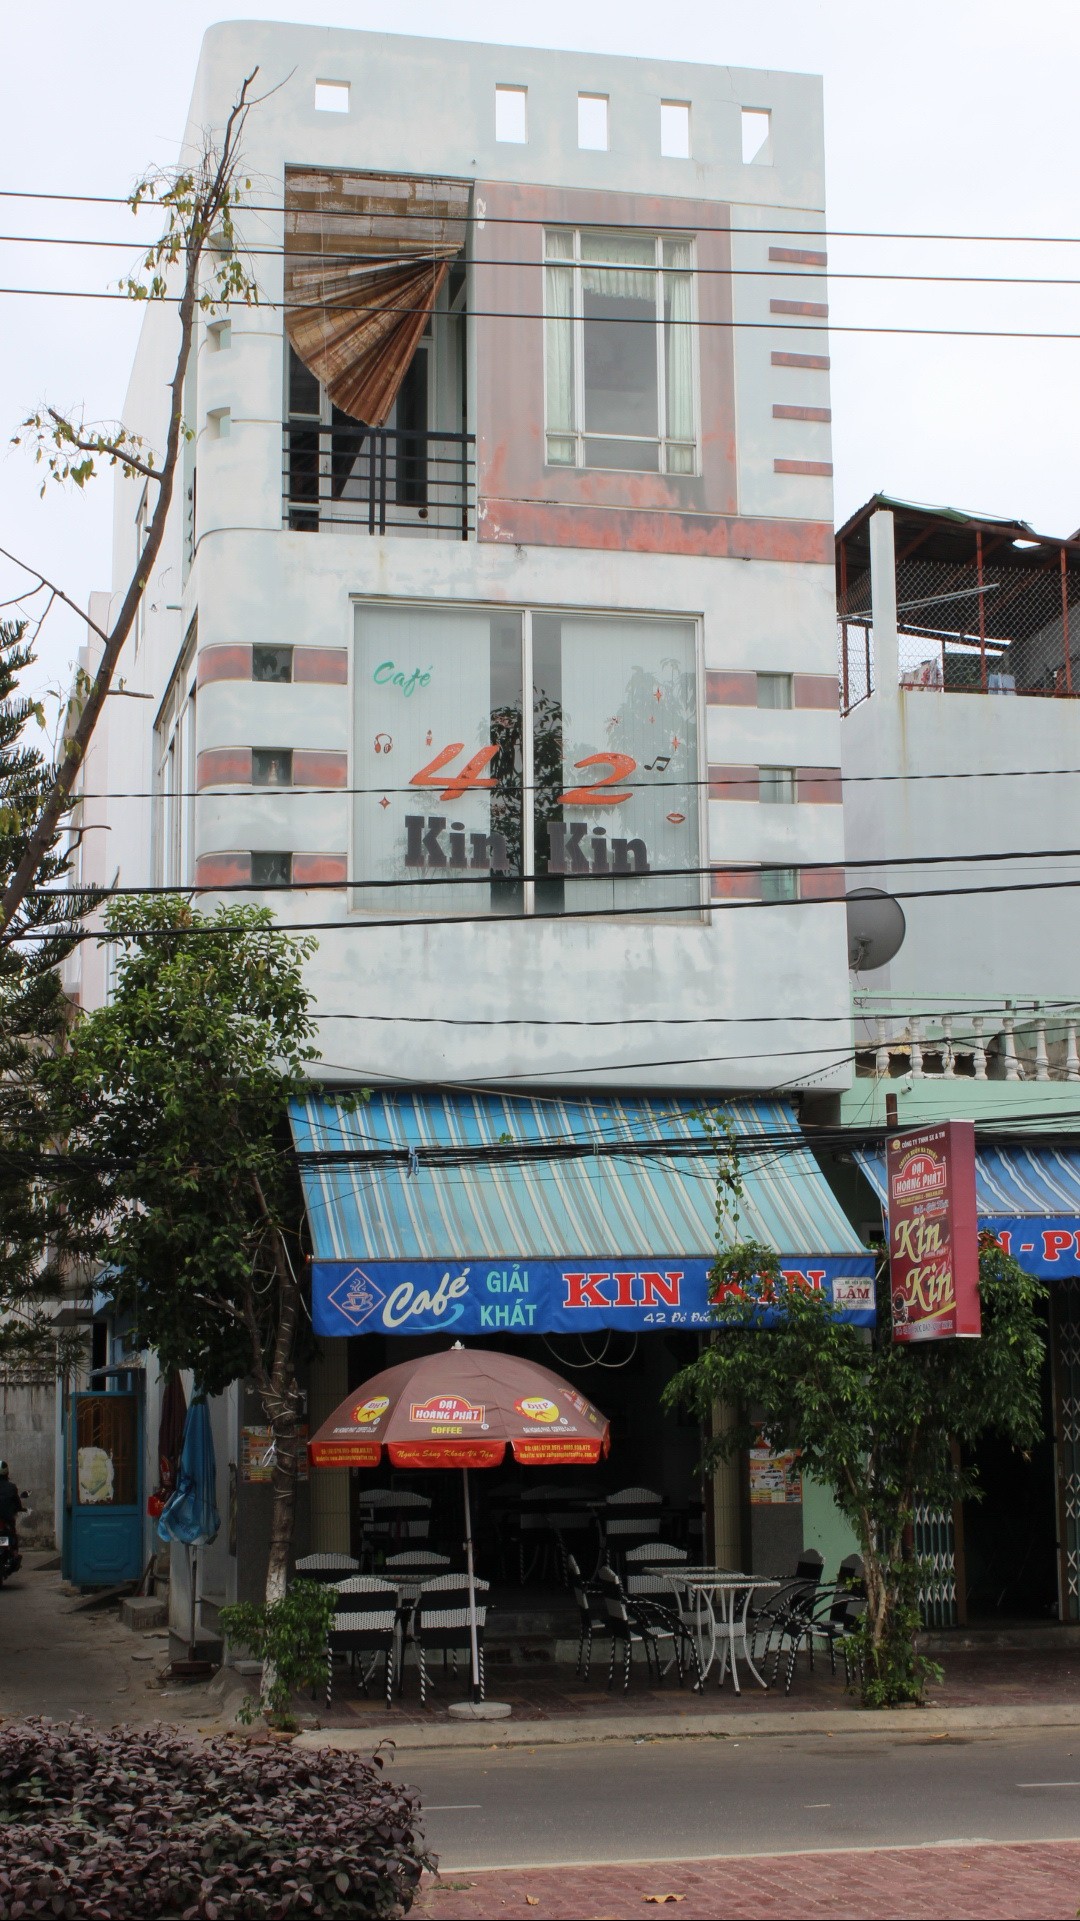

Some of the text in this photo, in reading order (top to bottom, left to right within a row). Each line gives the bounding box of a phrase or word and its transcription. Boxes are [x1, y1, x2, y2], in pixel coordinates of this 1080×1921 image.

[373, 660, 434, 697] Café
[409, 742, 637, 805] 4 2
[405, 815, 650, 874] Kin Kin
[896, 1170, 942, 1194] HOÀNG PHÁT
[911, 1161, 925, 1176] ĐẠI
[893, 1214, 943, 1263] Kin
[486, 1264, 529, 1294] GIẢI
[562, 1272, 685, 1308] KIN
[836, 1285, 870, 1299] LÂM
[904, 1262, 954, 1312] Kin
[382, 1267, 472, 1329] Café
[480, 1298, 537, 1327] KHÁT
[643, 1312, 666, 1323] 42
[415, 1410, 479, 1420] HOÀNG PHÁT
[438, 1399, 457, 1411] ĐẠI
[431, 1426, 463, 1435] COFFEE
